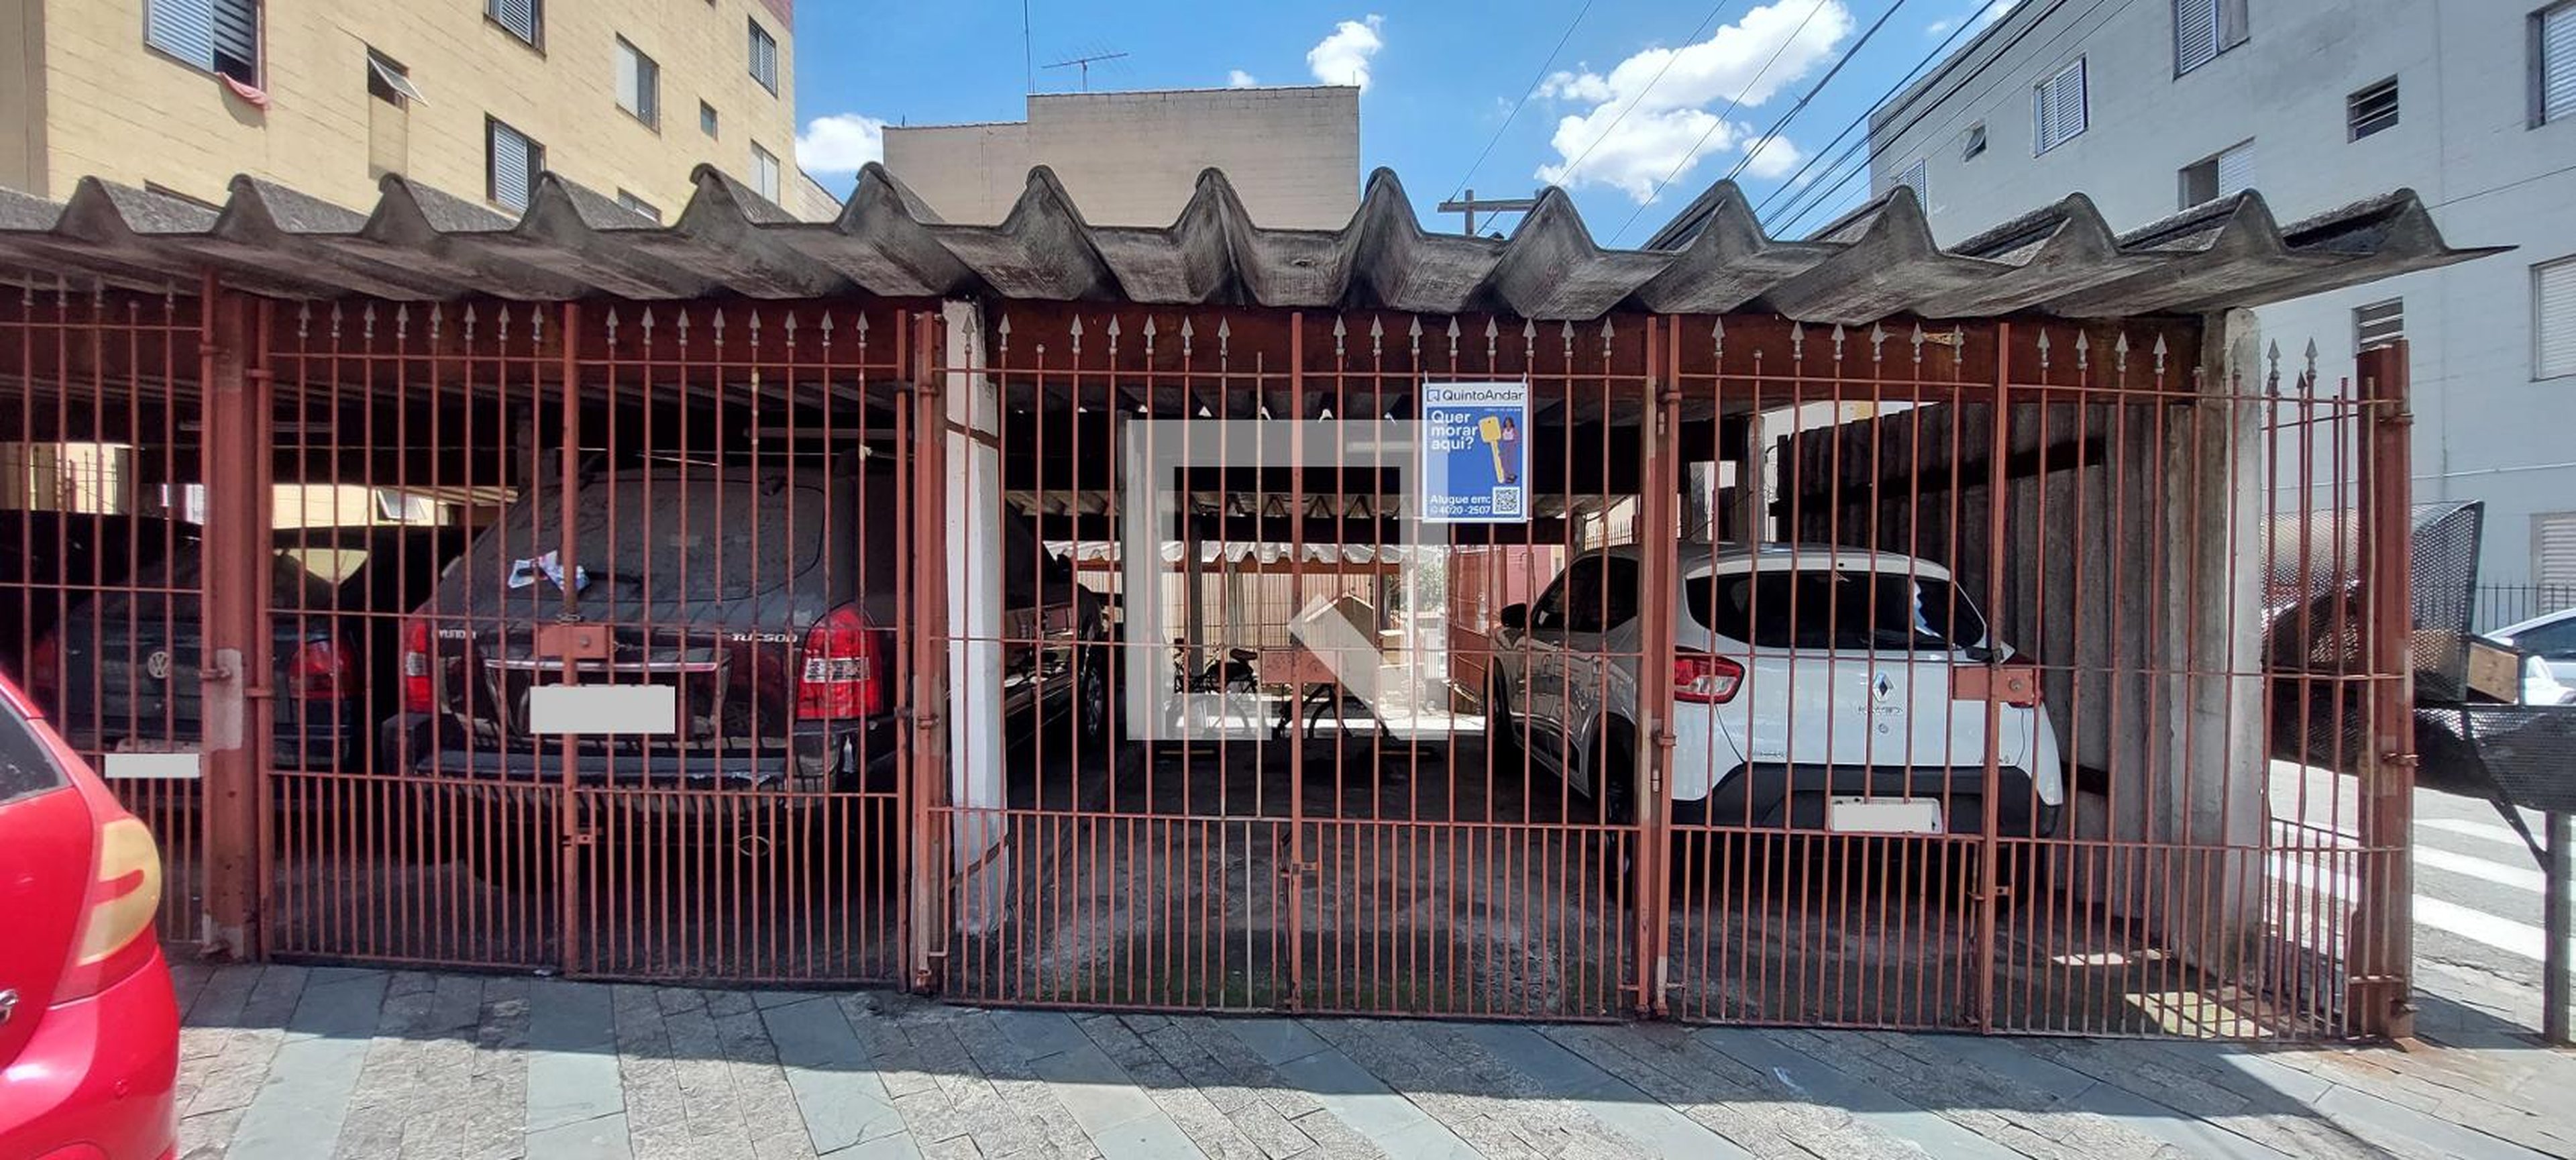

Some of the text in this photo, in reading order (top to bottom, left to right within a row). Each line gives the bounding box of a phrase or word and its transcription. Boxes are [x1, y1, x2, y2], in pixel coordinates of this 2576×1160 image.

[1443, 389, 1523, 401] QuintoAndar
[1432, 410, 1471, 423] Quer
[1431, 425, 1479, 436] morar
[1432, 437, 1474, 452] aqui?
[1430, 494, 1491, 505] Alugue em:
